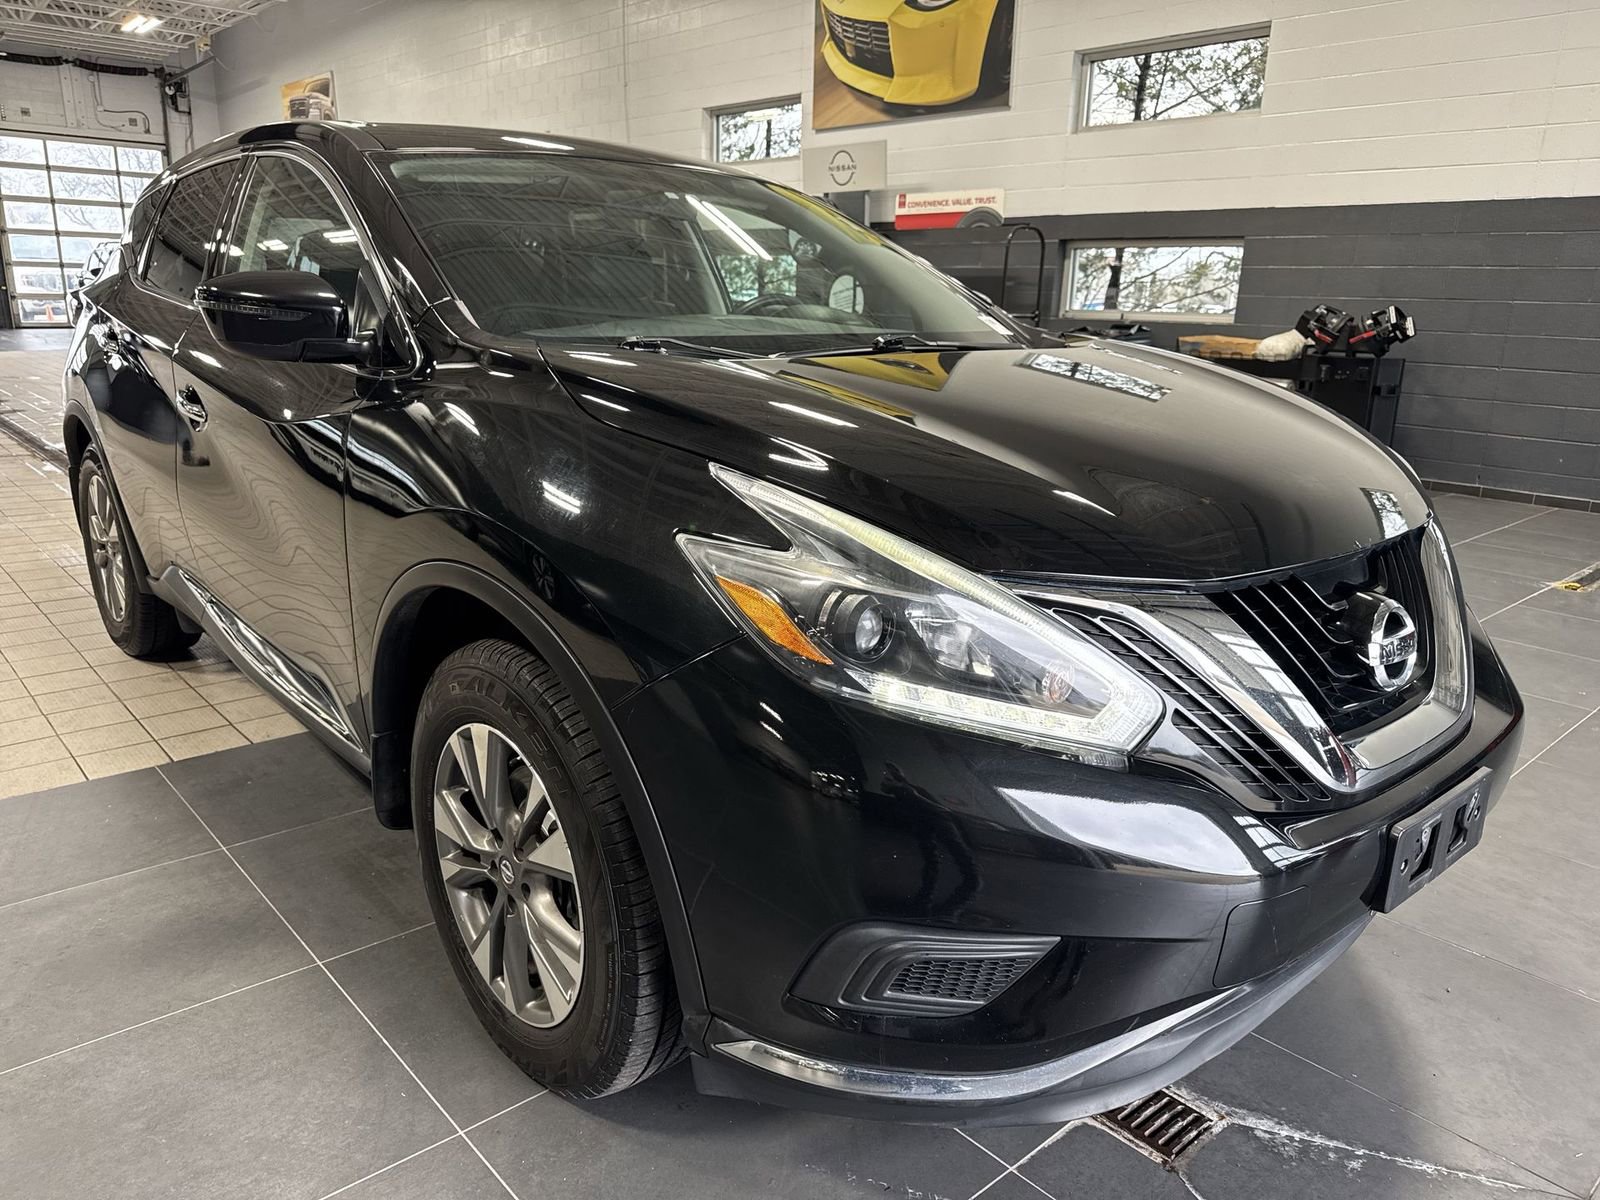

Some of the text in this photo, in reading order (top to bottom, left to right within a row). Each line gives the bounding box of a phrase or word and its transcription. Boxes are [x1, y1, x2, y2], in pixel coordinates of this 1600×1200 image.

[907, 200, 951, 209] CONVENIENCE.
[951, 198, 974, 206] VALUE.
[974, 196, 997, 204] TRUST.
